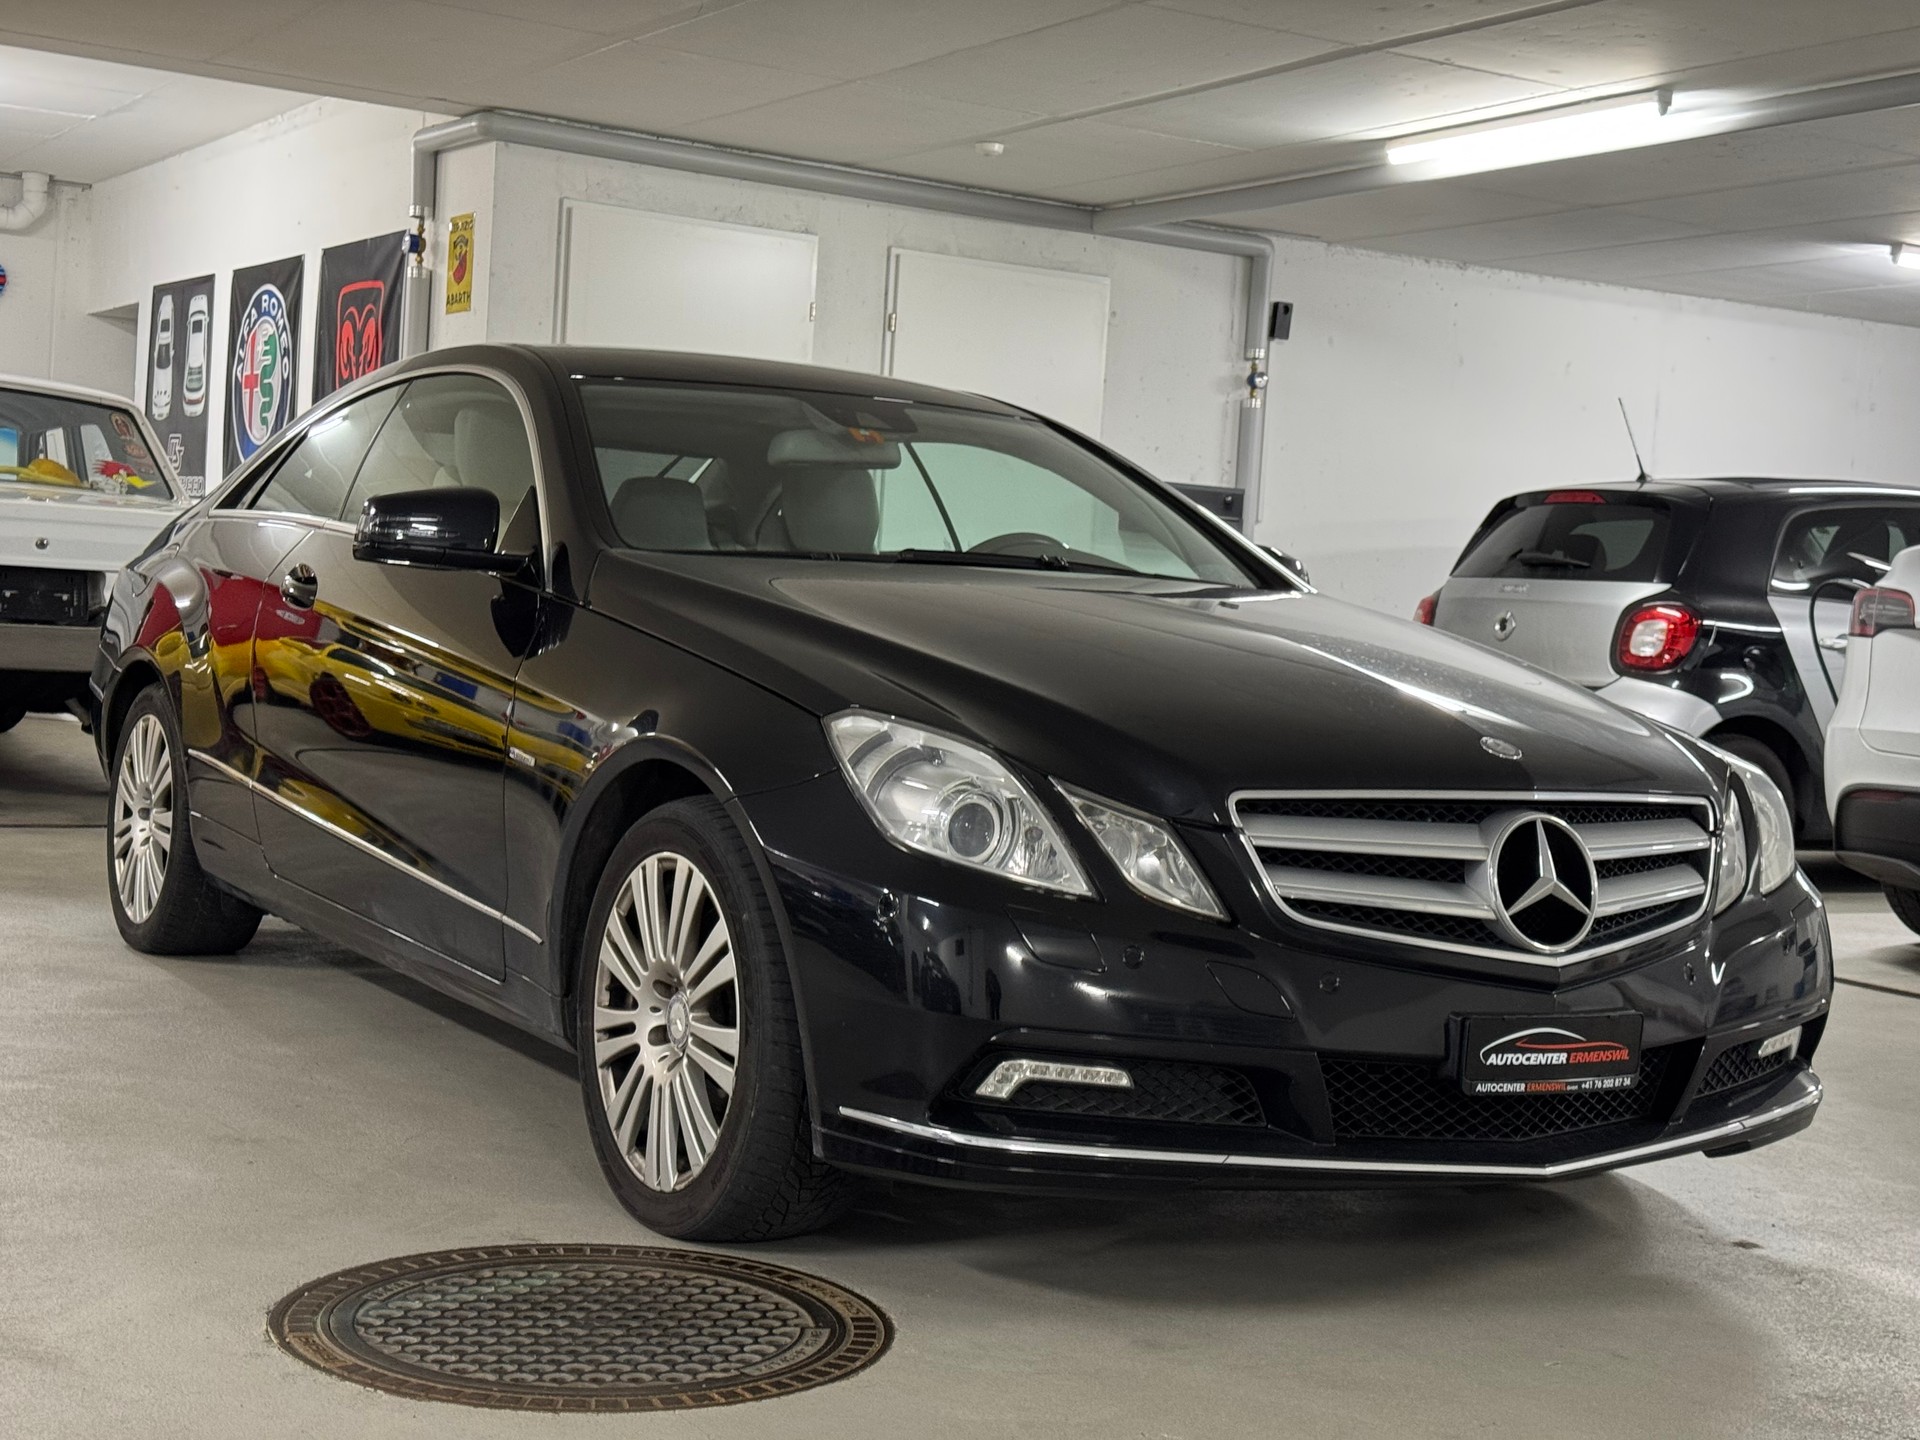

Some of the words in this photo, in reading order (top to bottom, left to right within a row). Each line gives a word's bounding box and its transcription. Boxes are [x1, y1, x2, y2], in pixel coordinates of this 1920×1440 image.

[446, 290, 471, 306] ABARTH
[236, 306, 259, 384] ALFA
[261, 293, 290, 381] ROMEO
[1485, 1052, 1568, 1066] AUTOCENTER
[1569, 1047, 1630, 1063] ERMENSWIL
[1475, 1082, 1526, 1093] AUTOCENTER
[1526, 1081, 1567, 1092] ERMENSWIL
